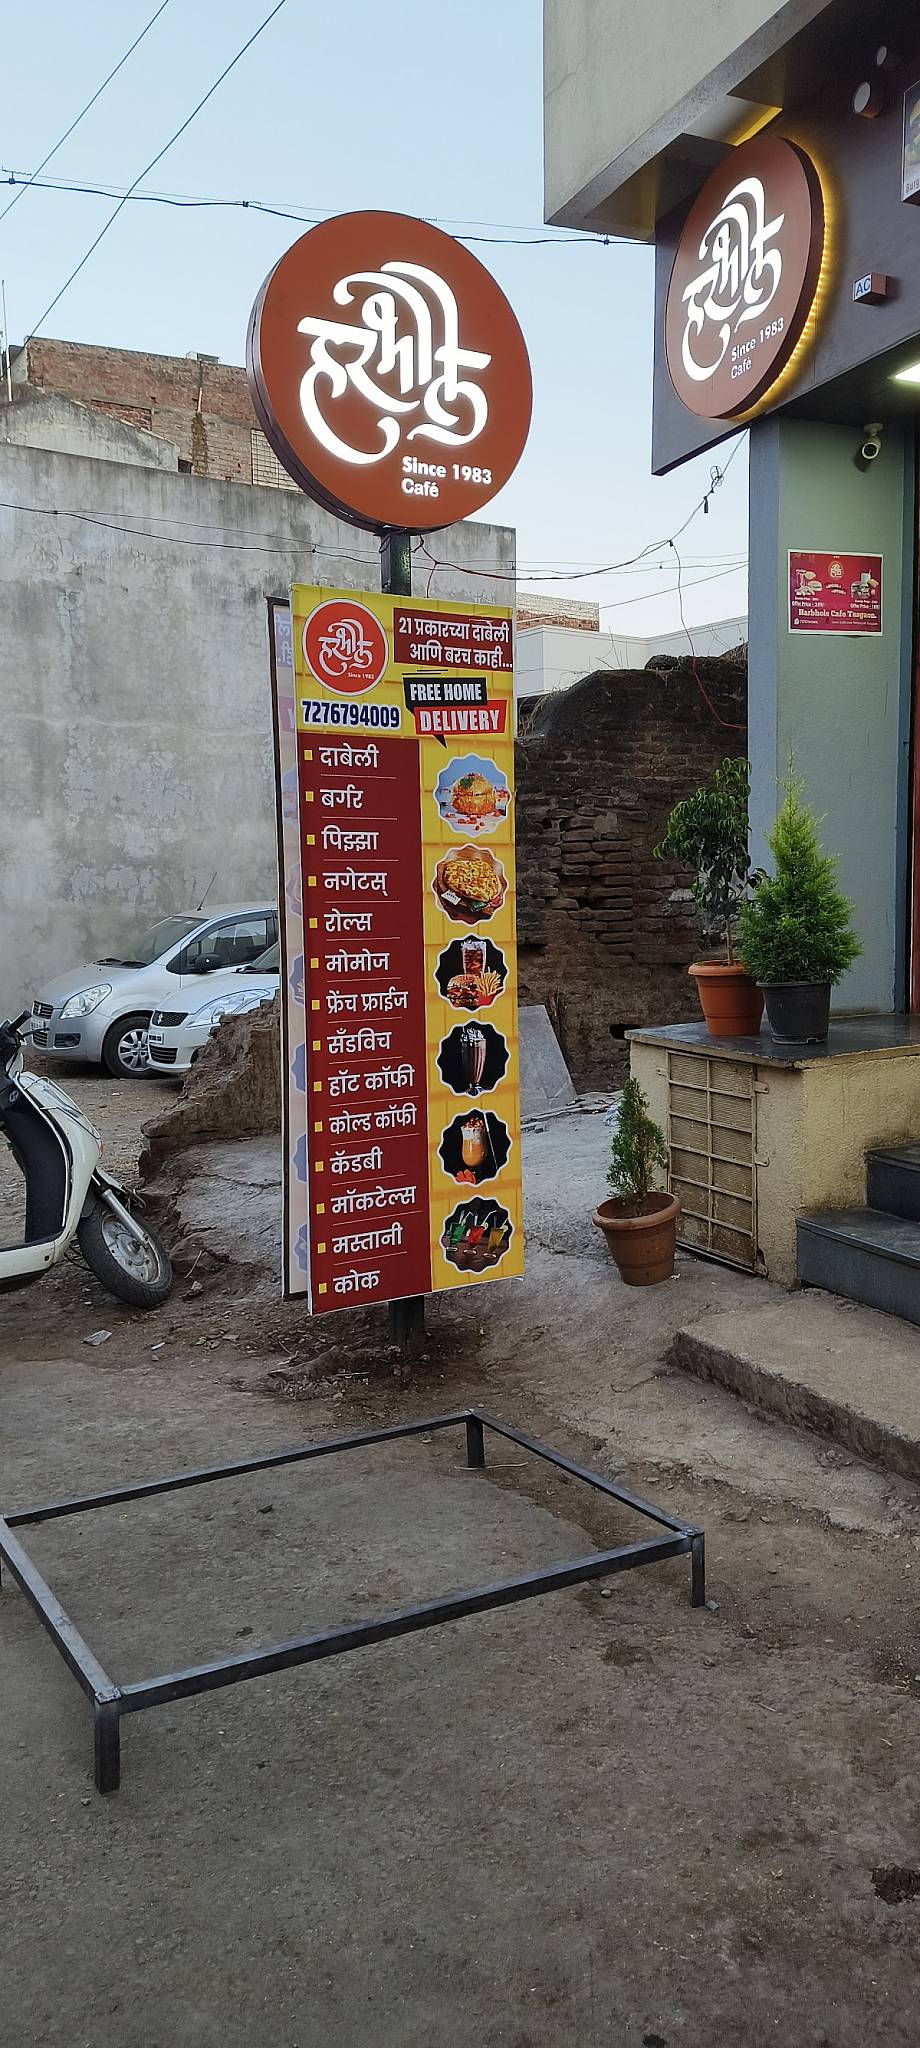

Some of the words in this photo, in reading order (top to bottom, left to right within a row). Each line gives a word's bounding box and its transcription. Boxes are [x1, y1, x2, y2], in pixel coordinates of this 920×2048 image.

[856, 278, 871, 297] AC
[731, 338, 756, 362] Since
[760, 317, 784, 343] 1983
[402, 455, 447, 478] Since
[452, 463, 492, 485] 1983
[402, 478, 439, 498] Café
[399, 617, 412, 634] 21
[414, 618, 470, 640] प्रकारच्या
[472, 621, 510, 643] दाबेली
[410, 640, 442, 662] आणि
[444, 646, 472, 665] बरच
[410, 683, 442, 701] FREE
[444, 683, 482, 701] HOME
[302, 700, 400, 728] 7276794009
[420, 709, 500, 732] DELIVERY
[318, 743, 380, 769] दाबेली
[320, 784, 363, 809] बर्गर
[322, 867, 389, 897] नगेटस्
[324, 908, 373, 932] रोल्स
[325, 949, 390, 973] मोमोज
[326, 990, 358, 1014] फ्रेंच
[361, 986, 409, 1012] फ्राईज
[328, 1069, 361, 1097] हॉट
[363, 1063, 415, 1090] कॉफी
[328, 1110, 372, 1135] कोल्ड
[374, 1102, 417, 1129] कॉफी
[329, 1145, 383, 1175] कॅडबी
[331, 1185, 417, 1214] मॉकटेल्स
[332, 1221, 403, 1254] मस्तानी
[333, 1269, 381, 1294] कोक
